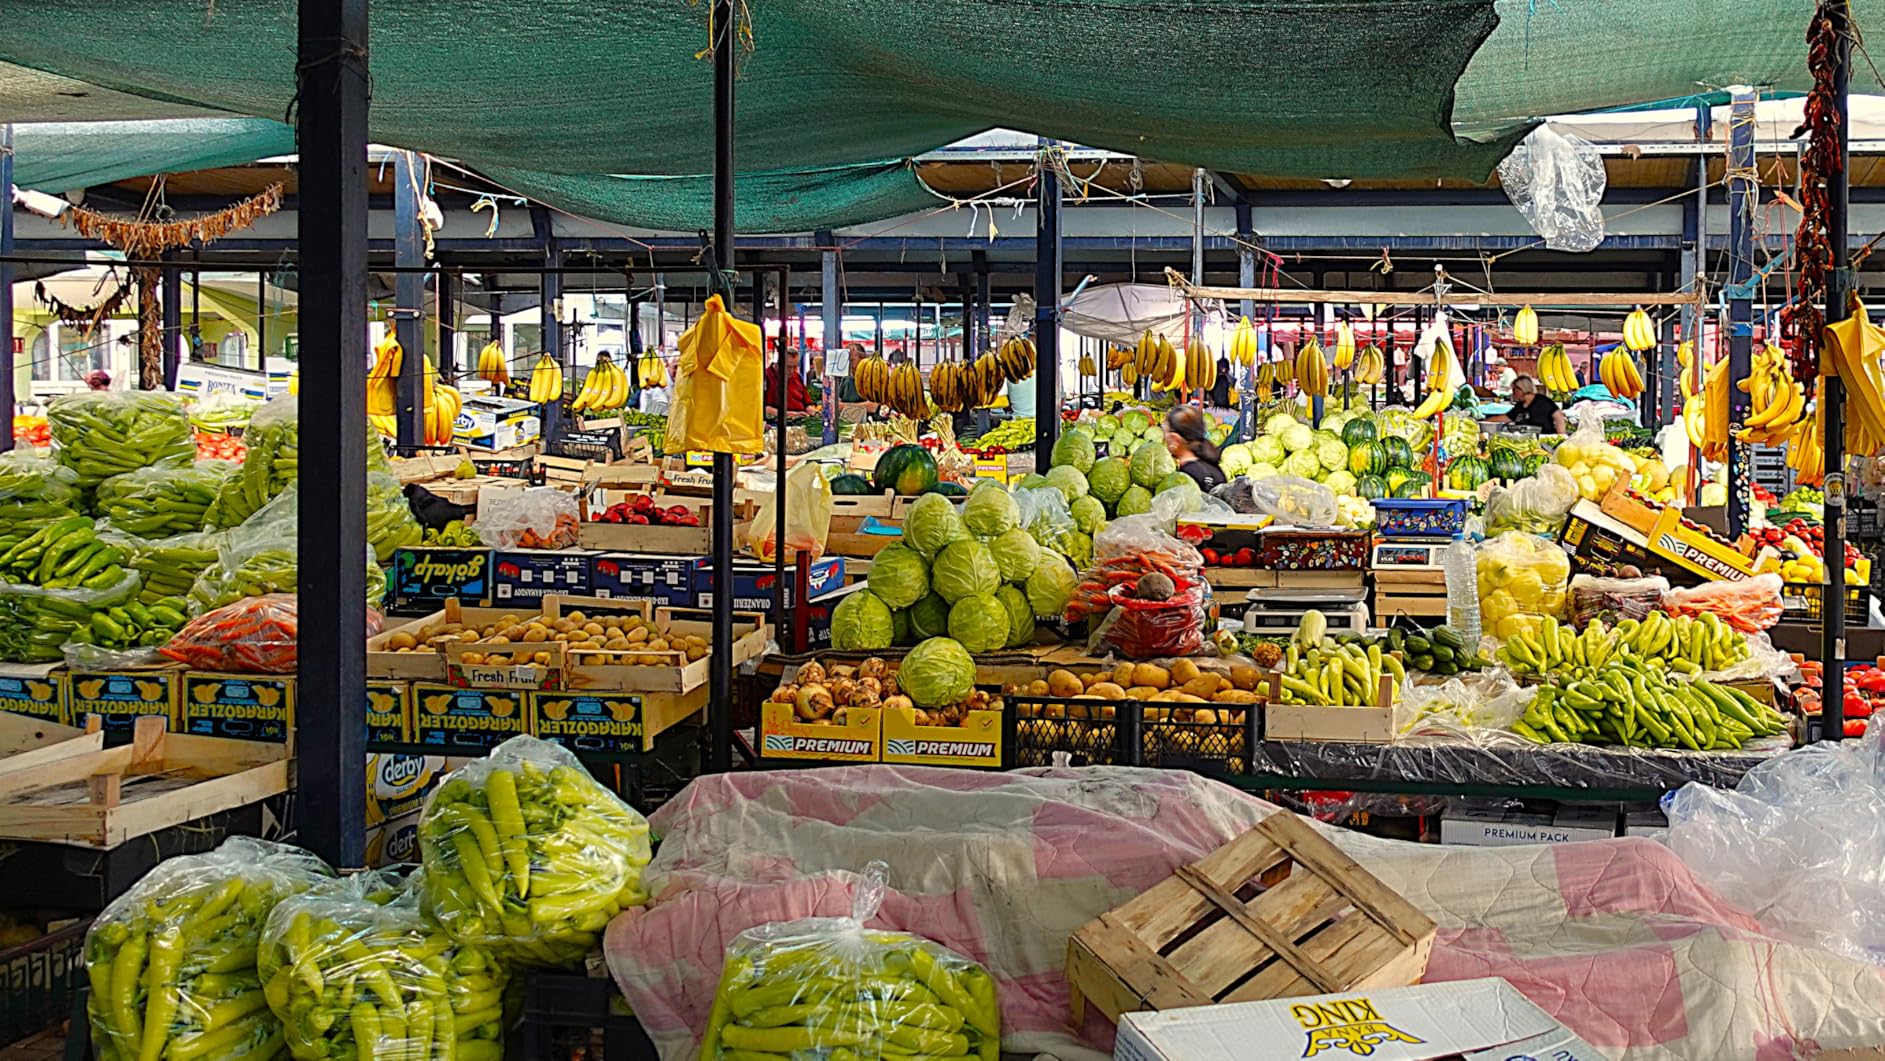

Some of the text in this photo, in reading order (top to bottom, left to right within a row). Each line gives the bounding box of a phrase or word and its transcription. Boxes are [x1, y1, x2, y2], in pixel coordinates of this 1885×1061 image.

[673, 474, 695, 484] Fresh
[414, 554, 485, 584] gökalp
[472, 669, 504, 683] Fresh
[189, 702, 286, 721] KARAGÖZLER
[421, 713, 521, 733] KARAGÖZLER
[539, 719, 642, 737] KARAGÖZLER
[794, 738, 871, 754] PREMIUM
[916, 741, 993, 757] PREMIUM
[384, 755, 422, 782] derby
[1484, 827, 1569, 842] PREMIUM PACK
[1290, 998, 1384, 1028] KING
[1319, 1024, 1376, 1037] BANA
